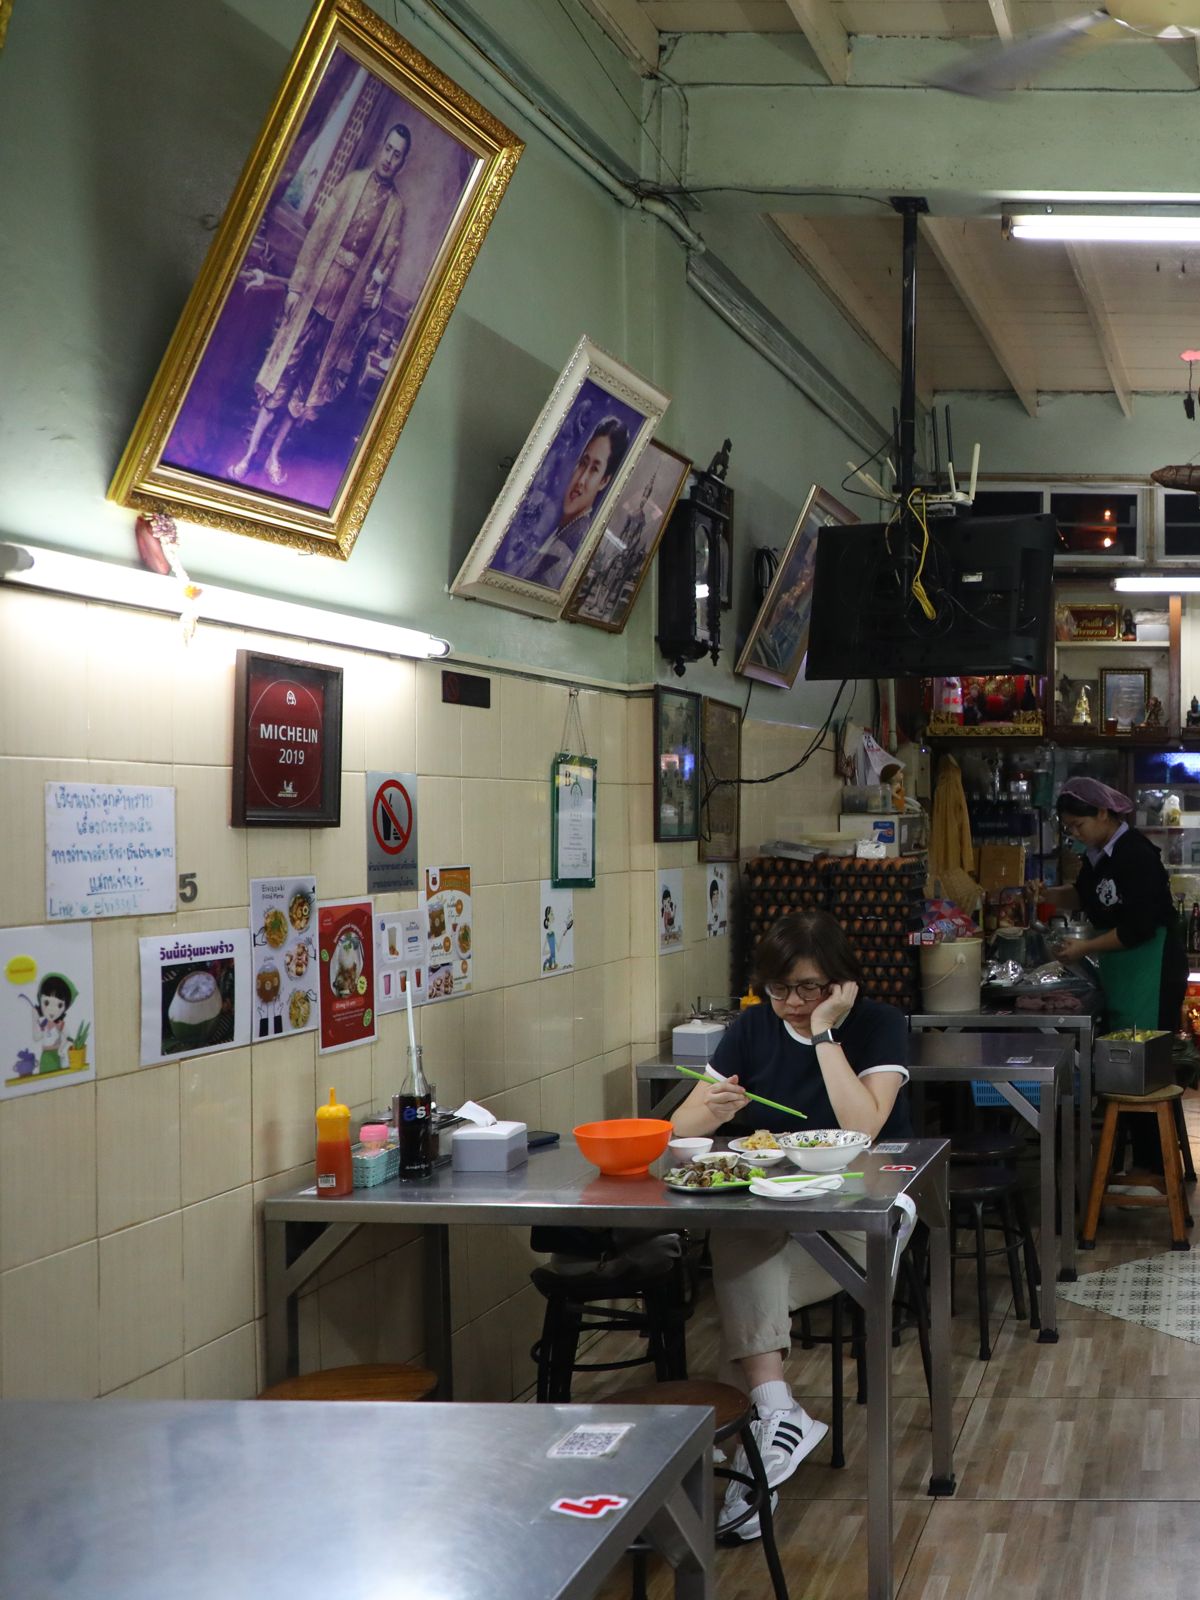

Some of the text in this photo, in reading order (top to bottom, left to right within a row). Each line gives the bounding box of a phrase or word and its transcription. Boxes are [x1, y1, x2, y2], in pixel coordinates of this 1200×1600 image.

[260, 723, 318, 743] MICHELIN
[279, 748, 305, 765] 2019
[179, 872, 198, 903] 5
[160, 940, 234, 960] วันนี้มีวุ้นมะพร้าว
[554, 1496, 625, 1517] 4
